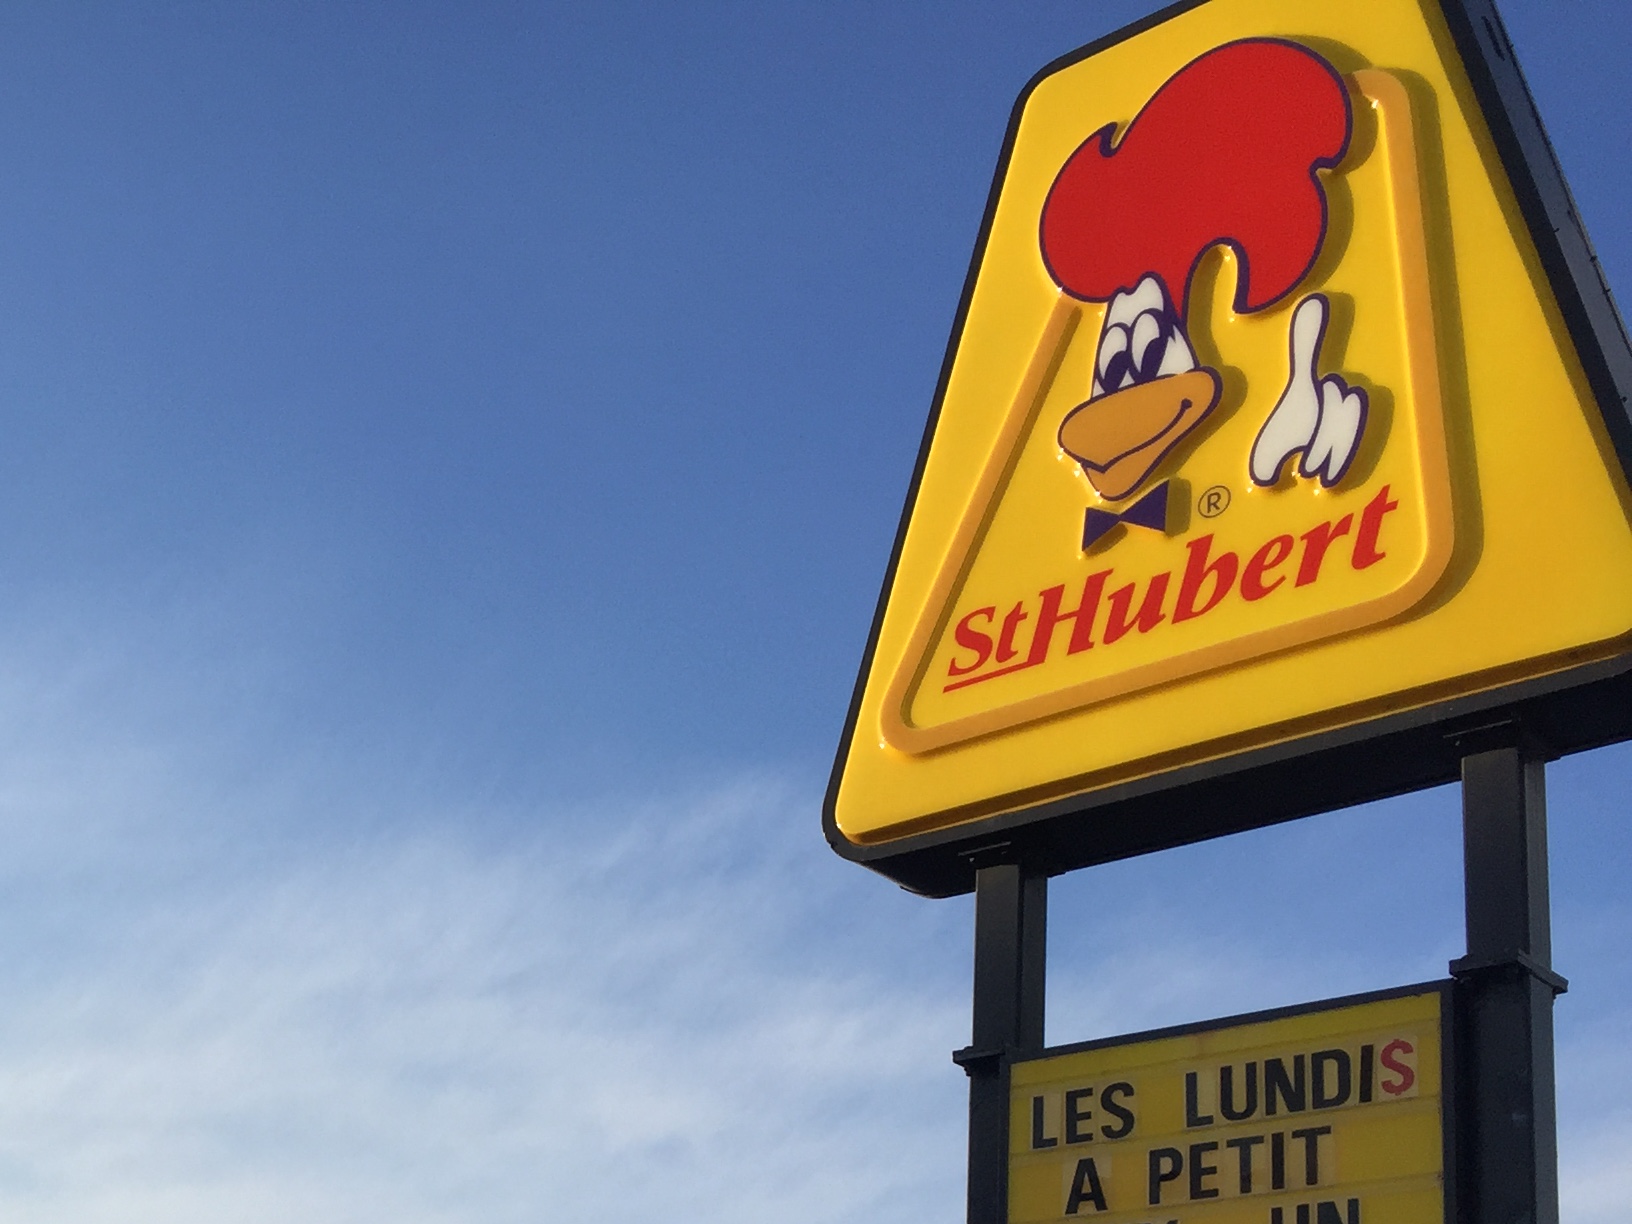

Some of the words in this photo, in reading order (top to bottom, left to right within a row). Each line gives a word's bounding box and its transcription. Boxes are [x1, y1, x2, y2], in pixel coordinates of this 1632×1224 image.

[1031, 1081, 1135, 1149] LES
[1065, 1158, 1108, 1215] A
[1148, 1125, 1332, 1206] PETIT
